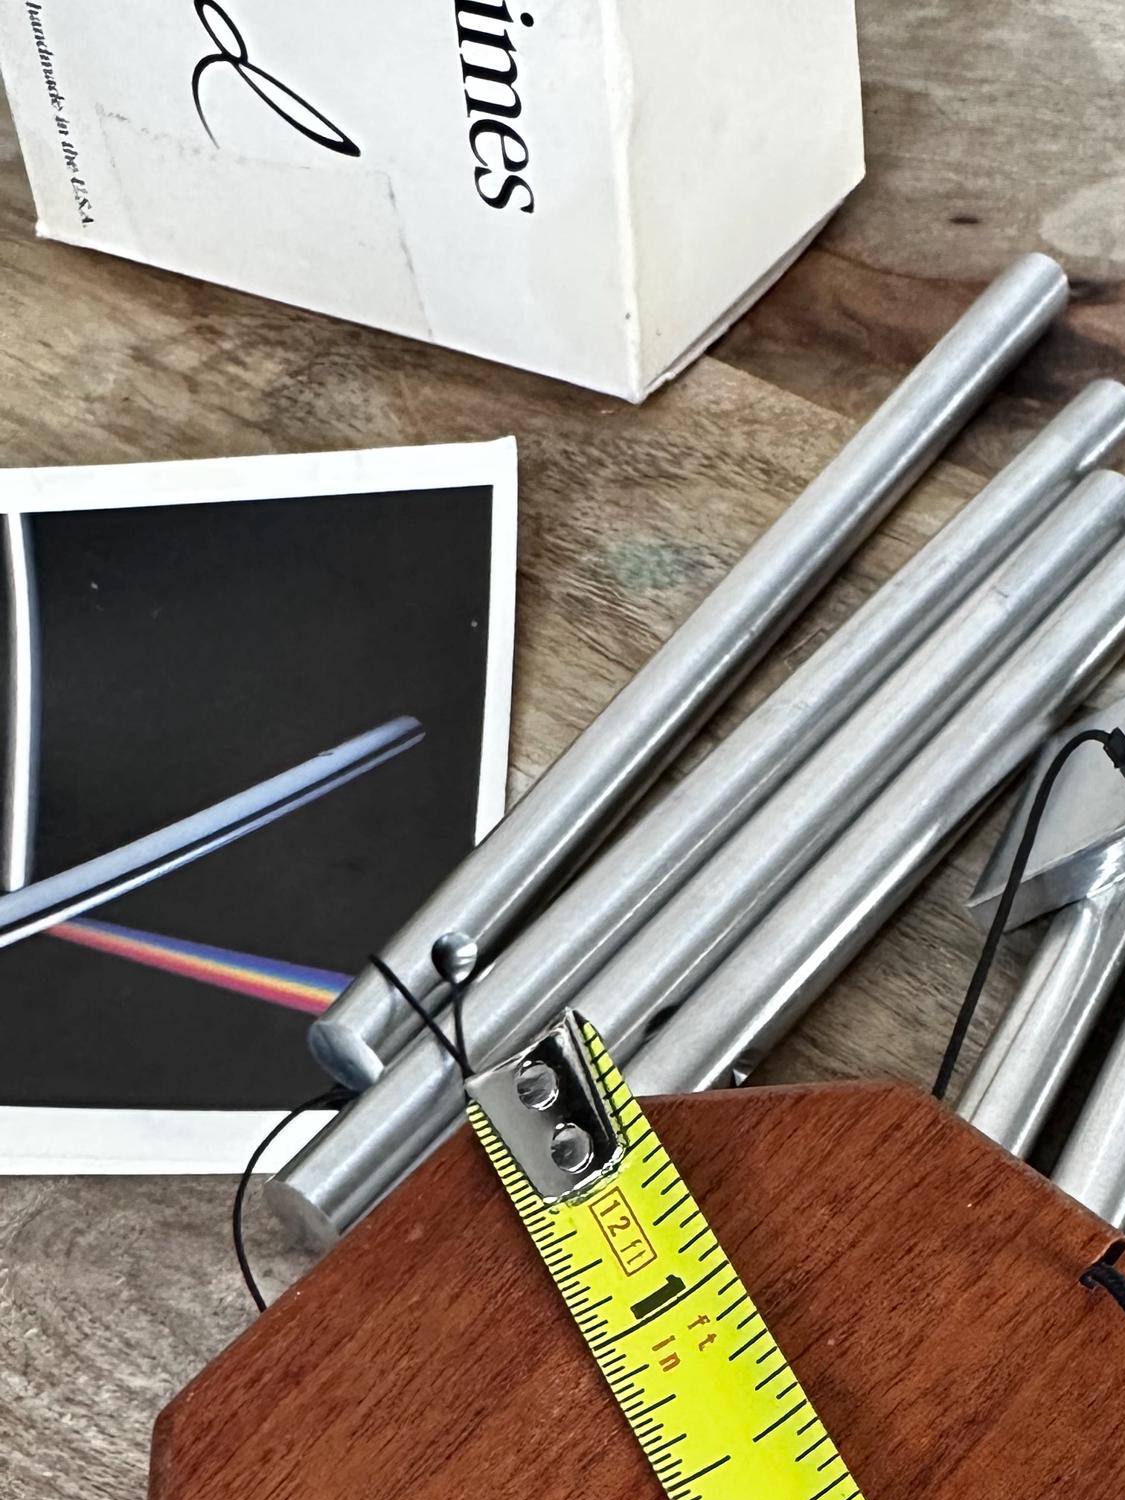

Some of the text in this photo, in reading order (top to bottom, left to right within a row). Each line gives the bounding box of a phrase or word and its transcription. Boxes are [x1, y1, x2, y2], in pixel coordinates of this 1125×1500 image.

[25, 1, 65, 111] handmade
[55, 115, 70, 136] in
[61, 141, 79, 173] the
[630, 1274, 687, 1320] 1
[687, 1314, 717, 1352] ft
